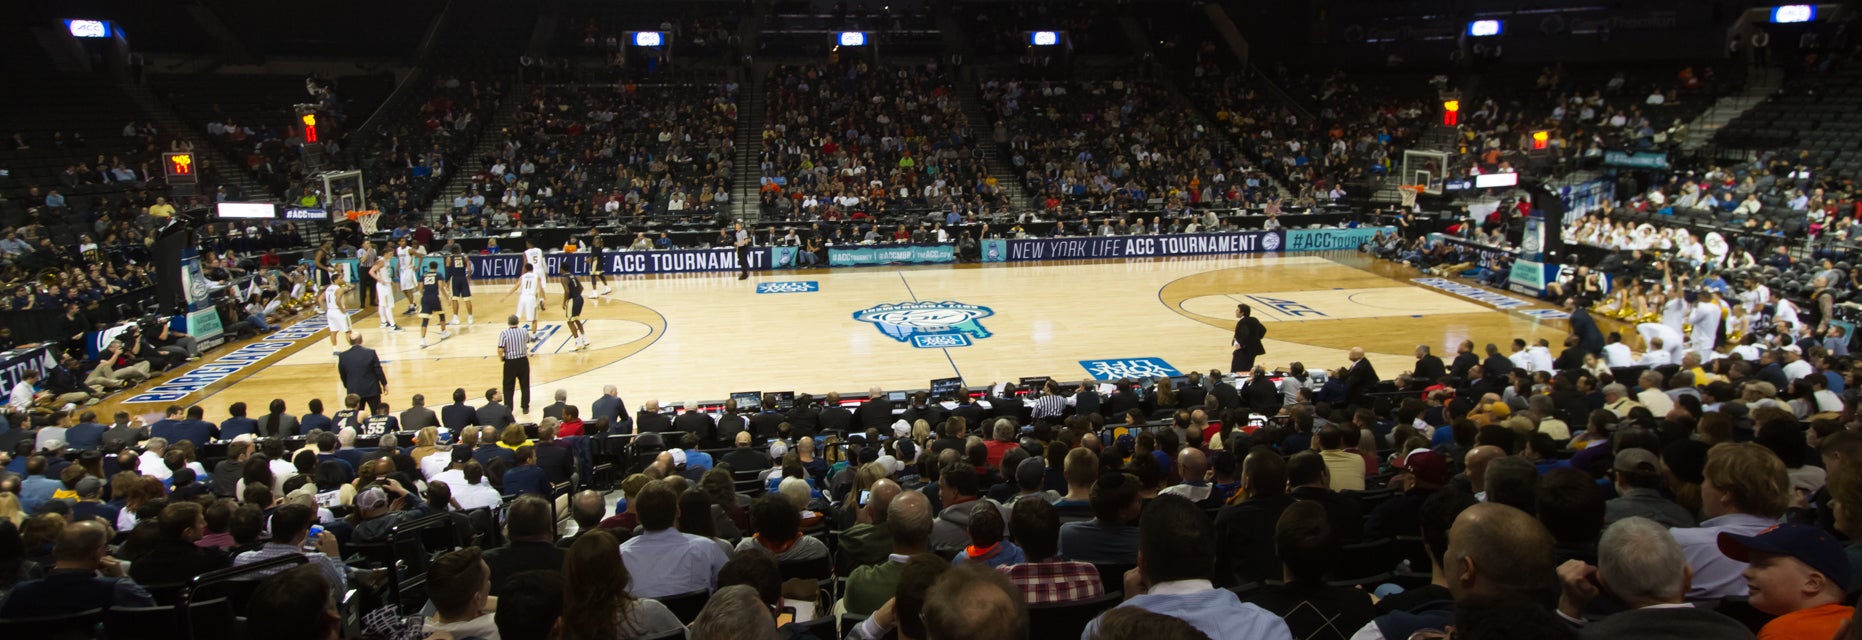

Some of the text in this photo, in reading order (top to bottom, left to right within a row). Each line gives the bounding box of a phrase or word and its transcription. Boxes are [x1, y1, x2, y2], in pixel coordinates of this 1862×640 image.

[1013, 234, 1258, 260] NEW YORK LIFE ACC TOURNAMENT
[482, 258, 519, 277] NEW
[611, 254, 645, 273] ACC
[532, 255, 539, 265] 5
[423, 276, 436, 286] 23
[525, 279, 533, 290] 11
[120, 341, 296, 404] BARCLAYS
[367, 422, 387, 435] 55
